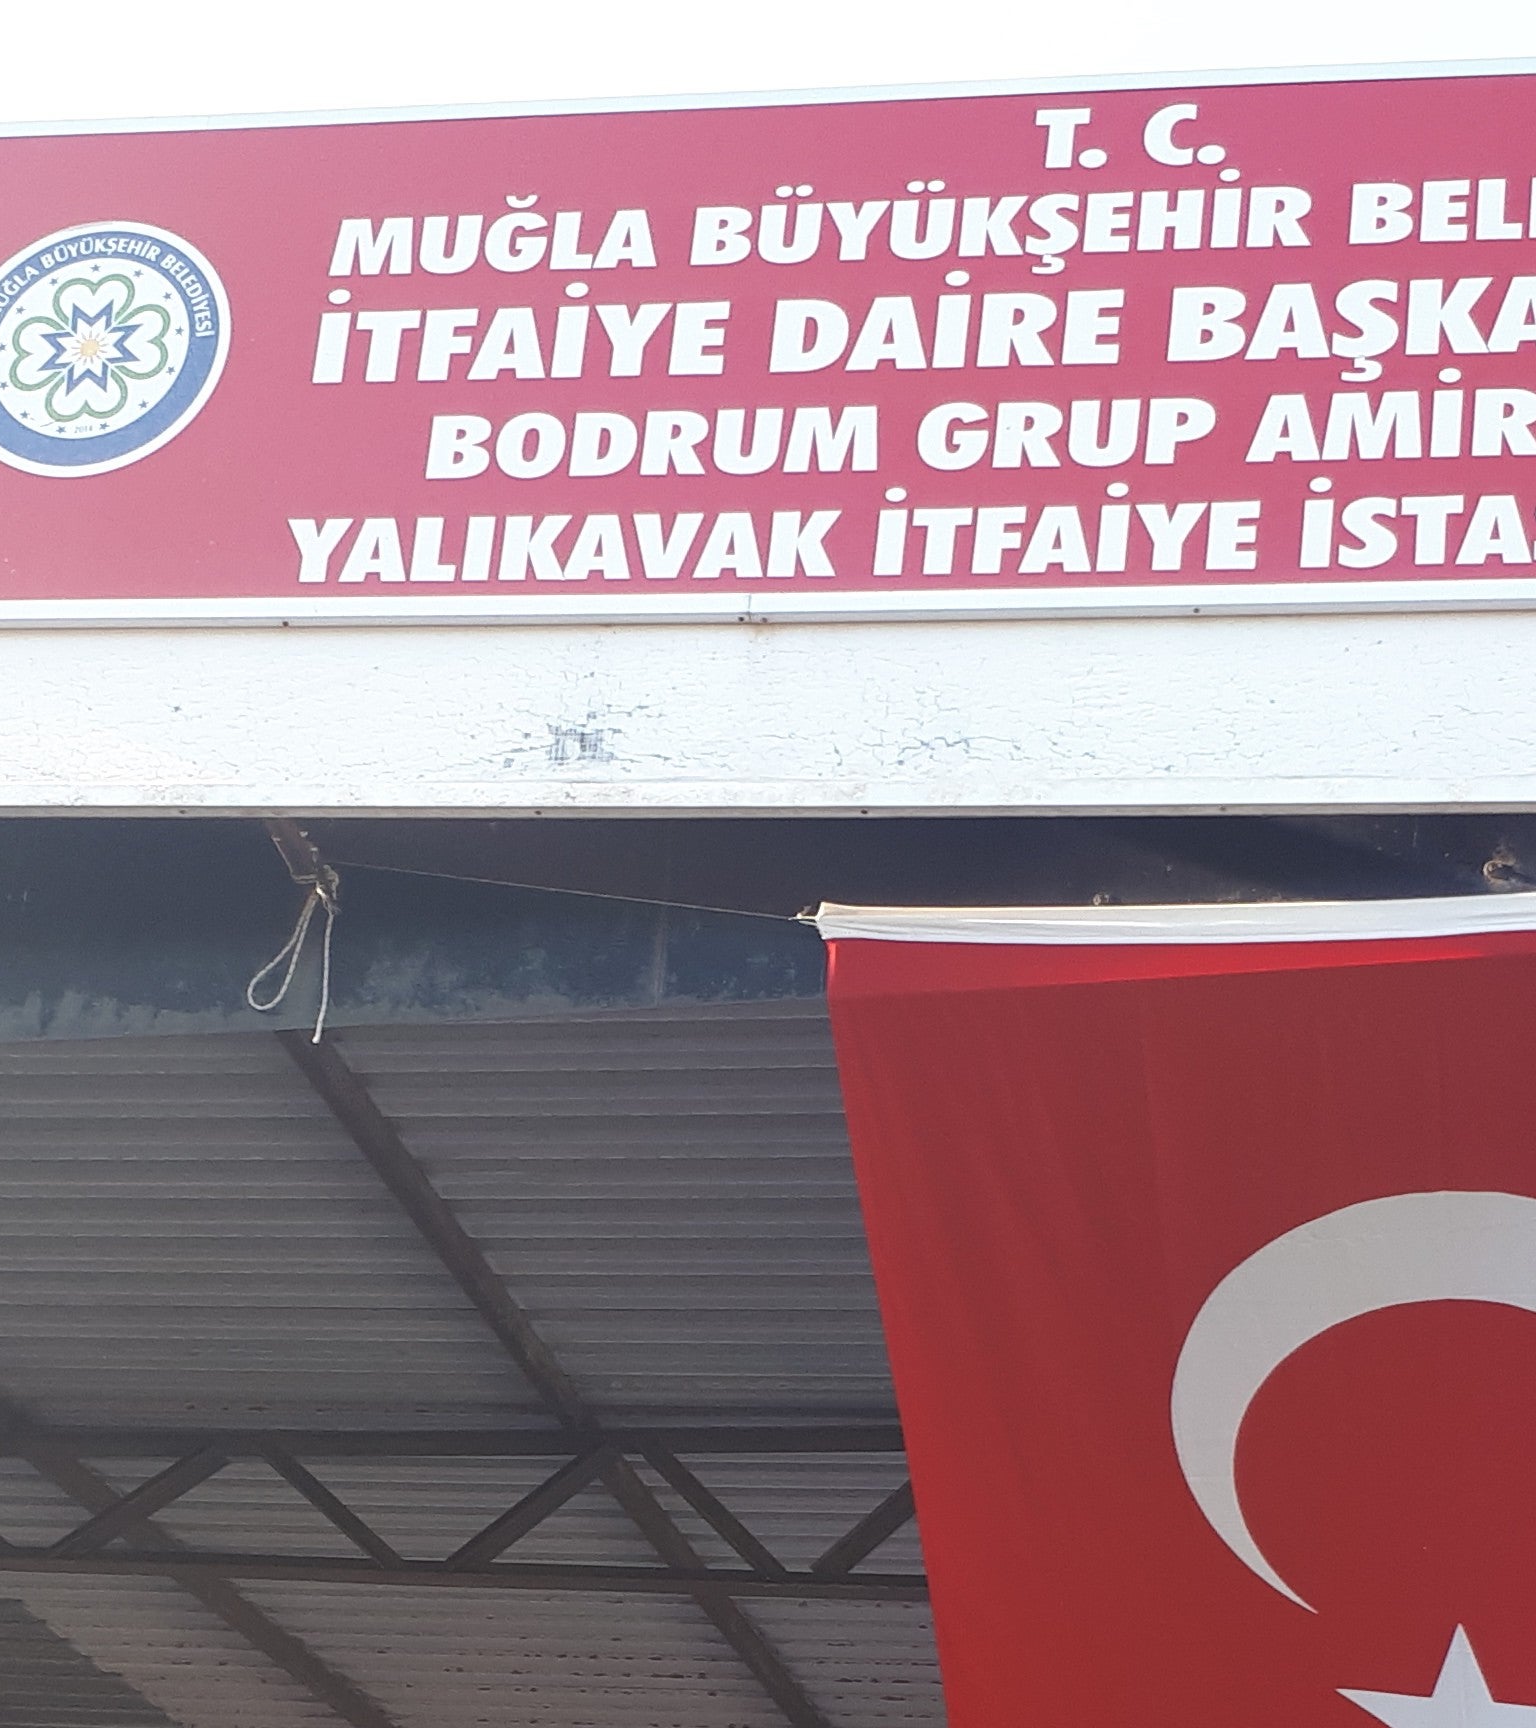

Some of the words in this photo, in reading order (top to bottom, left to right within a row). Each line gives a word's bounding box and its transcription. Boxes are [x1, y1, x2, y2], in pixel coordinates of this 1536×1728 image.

[1036, 105, 1108, 169] T.
[1144, 102, 1226, 166] C.
[39, 236, 162, 270] BÜYÜKŞEHİR
[328, 194, 657, 277] MUĞLA
[690, 169, 1312, 275] BÜYÜKŞEHİR
[312, 282, 731, 384] İTFAİYE
[770, 271, 1125, 374] DAİRE
[426, 404, 878, 481] BODRUM
[918, 397, 1217, 471] GRUP
[288, 509, 842, 583] YALIKAVAK
[873, 483, 1261, 577] İTFAİYE
